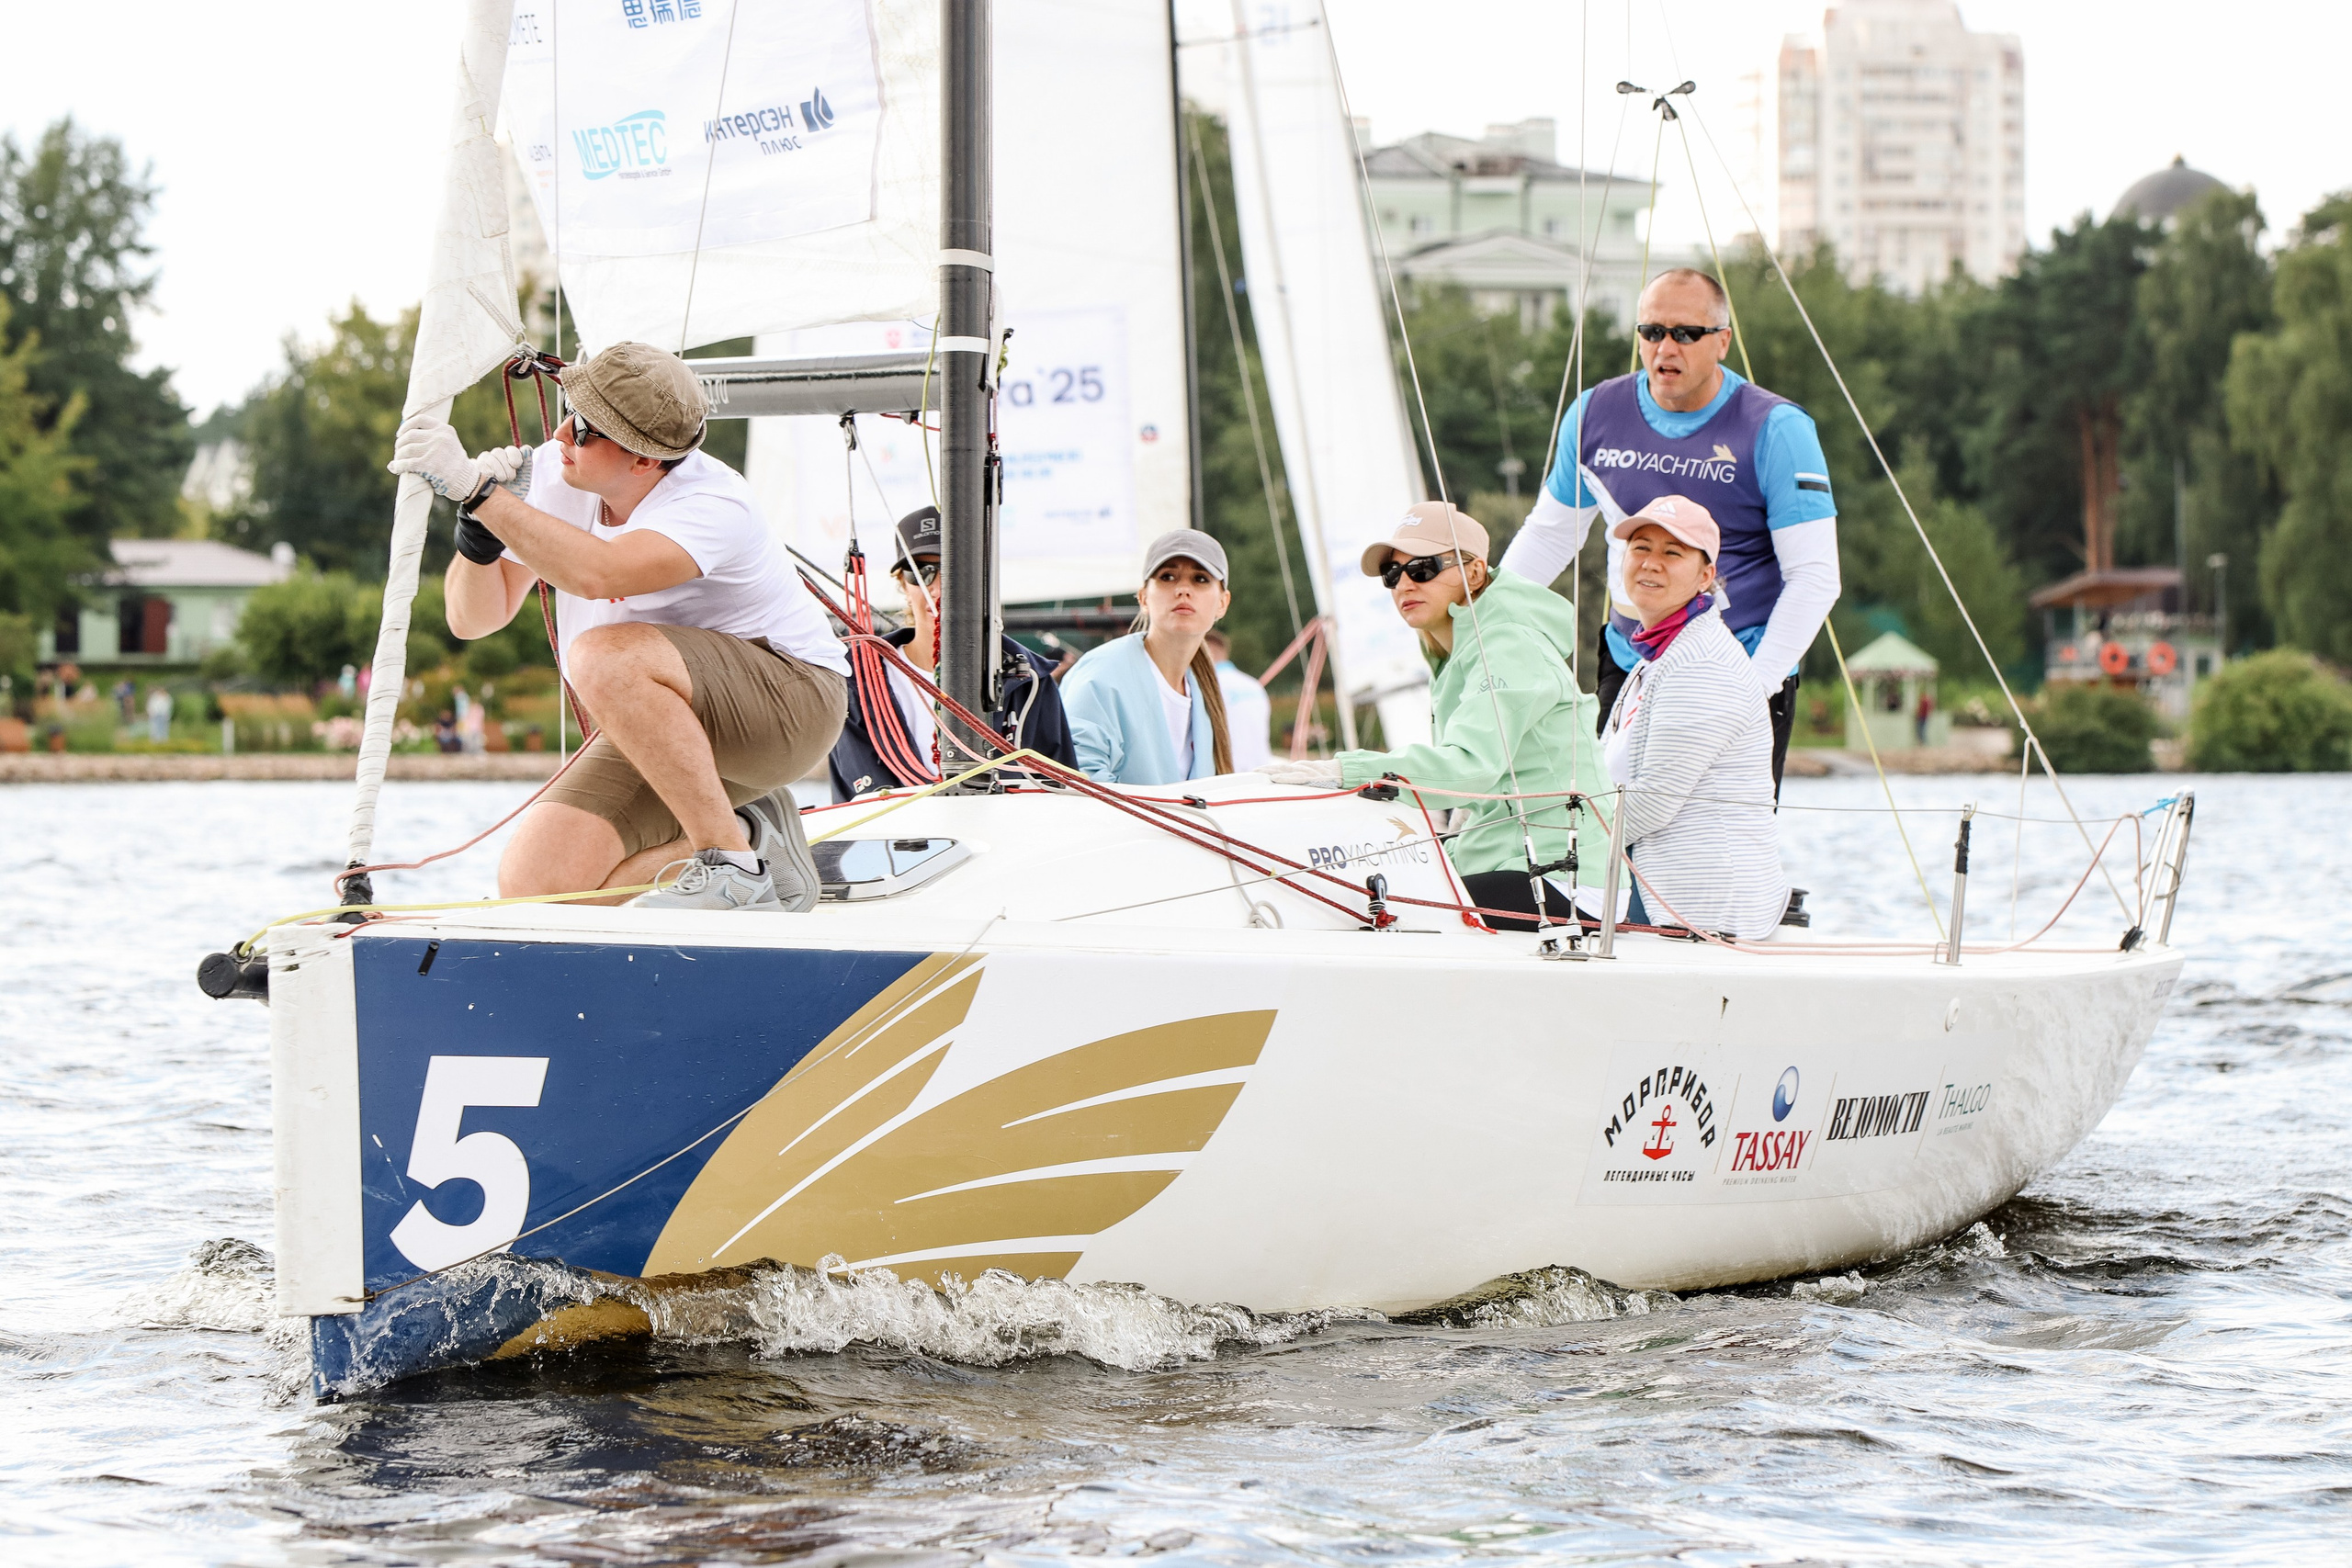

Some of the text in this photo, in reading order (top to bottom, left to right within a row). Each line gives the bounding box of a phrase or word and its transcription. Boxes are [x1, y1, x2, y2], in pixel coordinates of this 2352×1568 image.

[571, 120, 667, 170] MEDTEC
[1593, 447, 1736, 484] PROYACHTING
[1307, 840, 1429, 871] PROYACHTING
[1604, 1066, 1715, 1149] МОРПРИБОР
[1826, 1090, 1931, 1143] ВЕДОМОСТИ
[1938, 1083, 1991, 1120] THALGO
[389, 1055, 550, 1273] 5
[1730, 1130, 1813, 1172] TASSAY
[1603, 1170, 1695, 1183] ЛЕГЕНДАРНЫЕ ЧАСЫ
